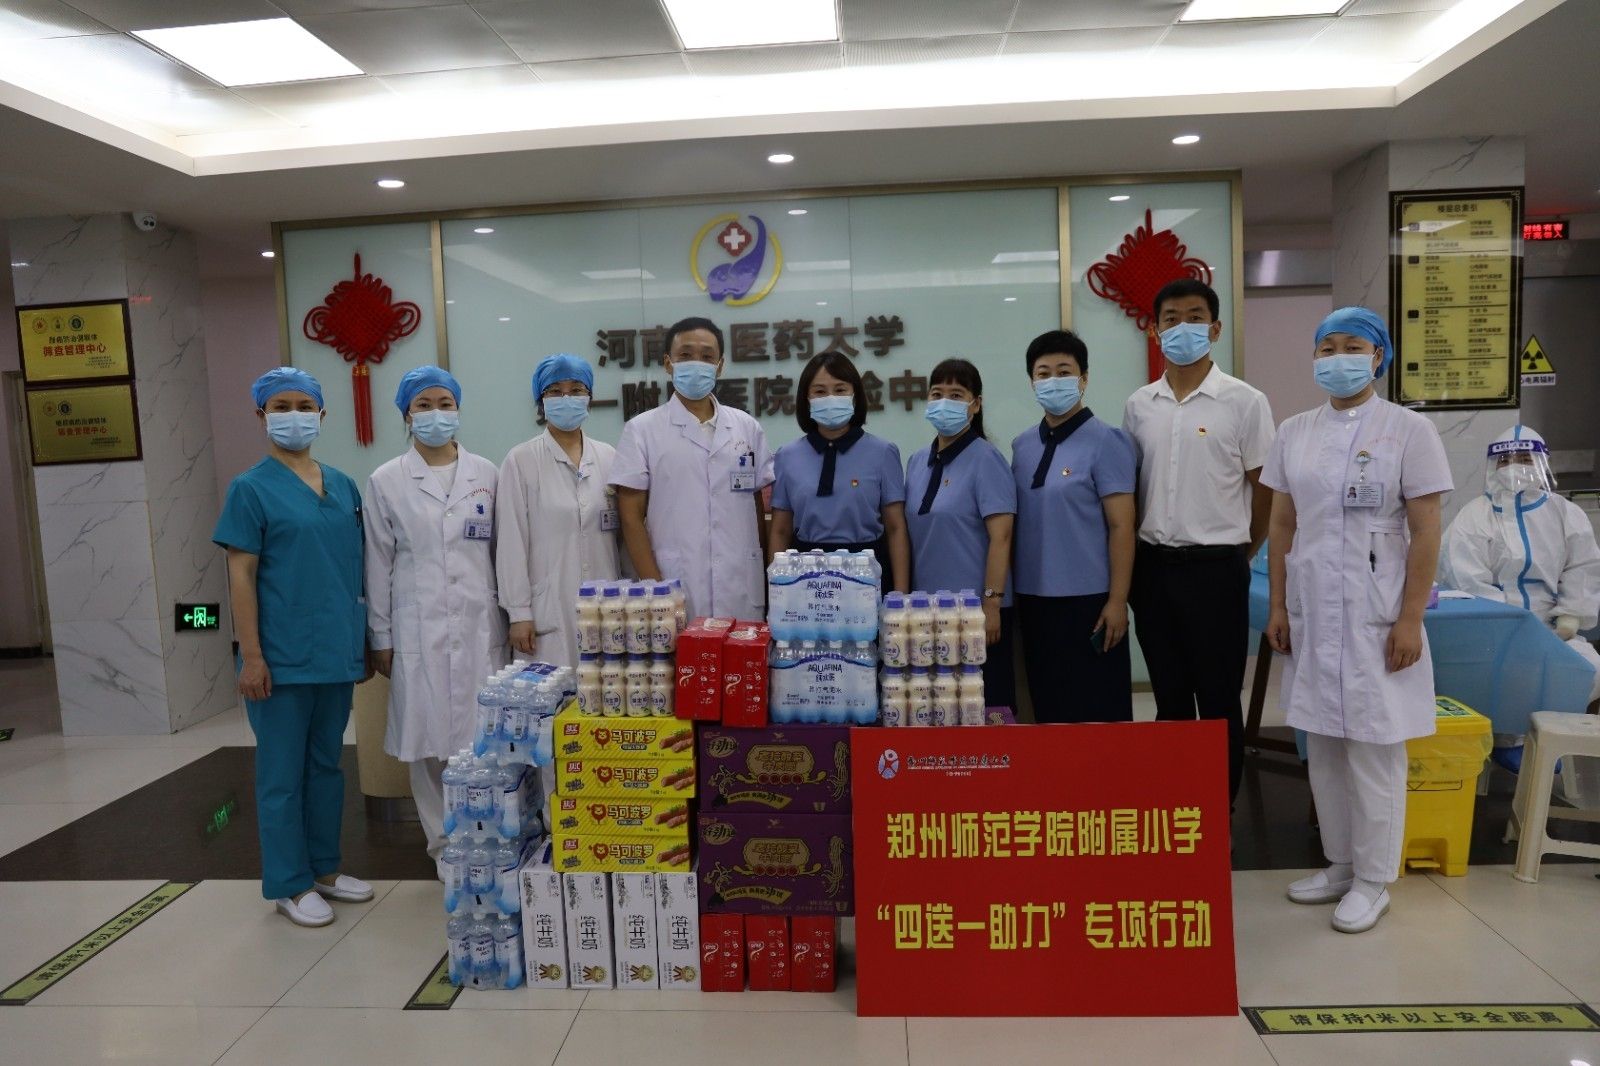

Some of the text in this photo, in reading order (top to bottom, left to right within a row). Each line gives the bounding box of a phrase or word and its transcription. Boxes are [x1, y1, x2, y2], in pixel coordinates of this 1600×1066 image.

[596, 314, 907, 369] 河南医药大学
[807, 580, 842, 590] AQUAFINA
[807, 663, 843, 674] AQUAFINA
[611, 729, 656, 743] 马可波罗
[613, 767, 659, 781] 马可波罗
[608, 804, 651, 819] 马可波罗
[887, 807, 1202, 859] 郑州师范学院附属小学
[609, 844, 654, 858] 马可波罗
[536, 914, 553, 948] 纯牛奶
[580, 916, 598, 950] 纯牛奶
[629, 914, 646, 949] 纯牛奶
[672, 915, 690, 950] 纯牛奶
[1289, 1010, 1565, 1027] 请保持1米以上安全距离
